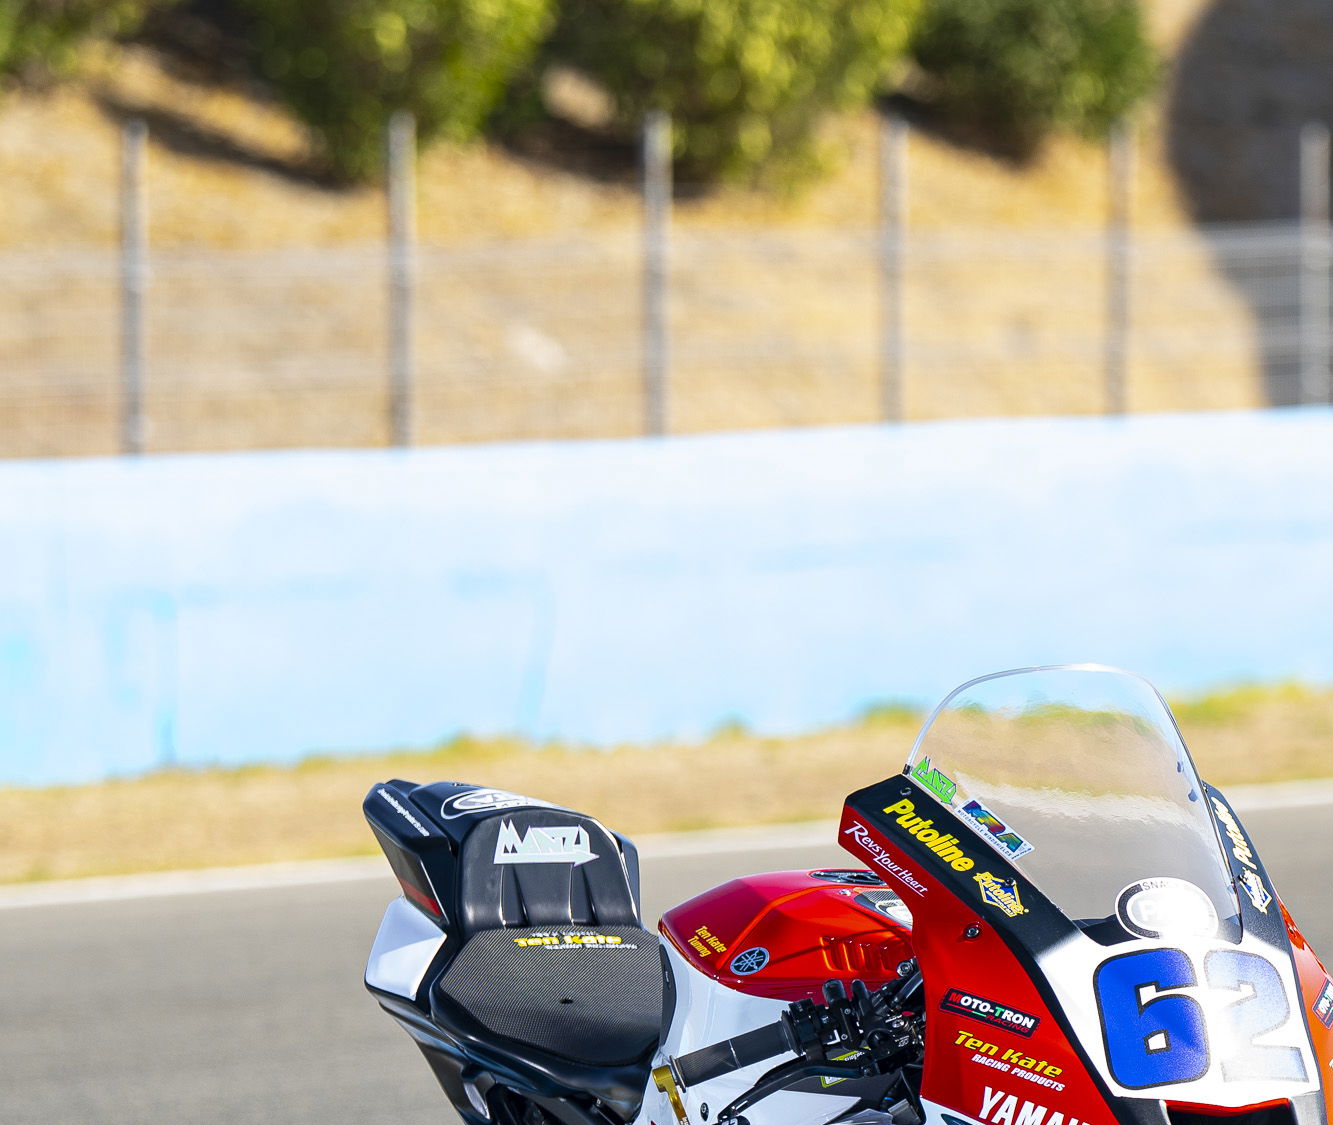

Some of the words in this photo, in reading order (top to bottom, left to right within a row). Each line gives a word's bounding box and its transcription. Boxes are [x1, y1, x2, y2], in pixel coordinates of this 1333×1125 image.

[883, 798, 976, 872] Putoline
[957, 809, 984, 833] MOTORCYCLE
[984, 832, 1012, 857] WINDSHIELDS
[844, 820, 882, 854] Revs
[874, 849, 902, 878] Your
[898, 868, 929, 895] Heart
[973, 871, 1025, 915] Putoline
[687, 935, 711, 957] Tuning
[695, 925, 711, 940] Ten
[710, 935, 727, 953] Kate
[949, 991, 1036, 1029] MOTO-TRON
[986, 1014, 1030, 1033] RACING
[1093, 947, 1310, 1091] 62
[954, 1030, 997, 1055] Ten
[1002, 1048, 1063, 1078] Kate
[971, 1054, 1011, 1073] RACING
[1011, 1065, 1066, 1092] PRODUCTS
